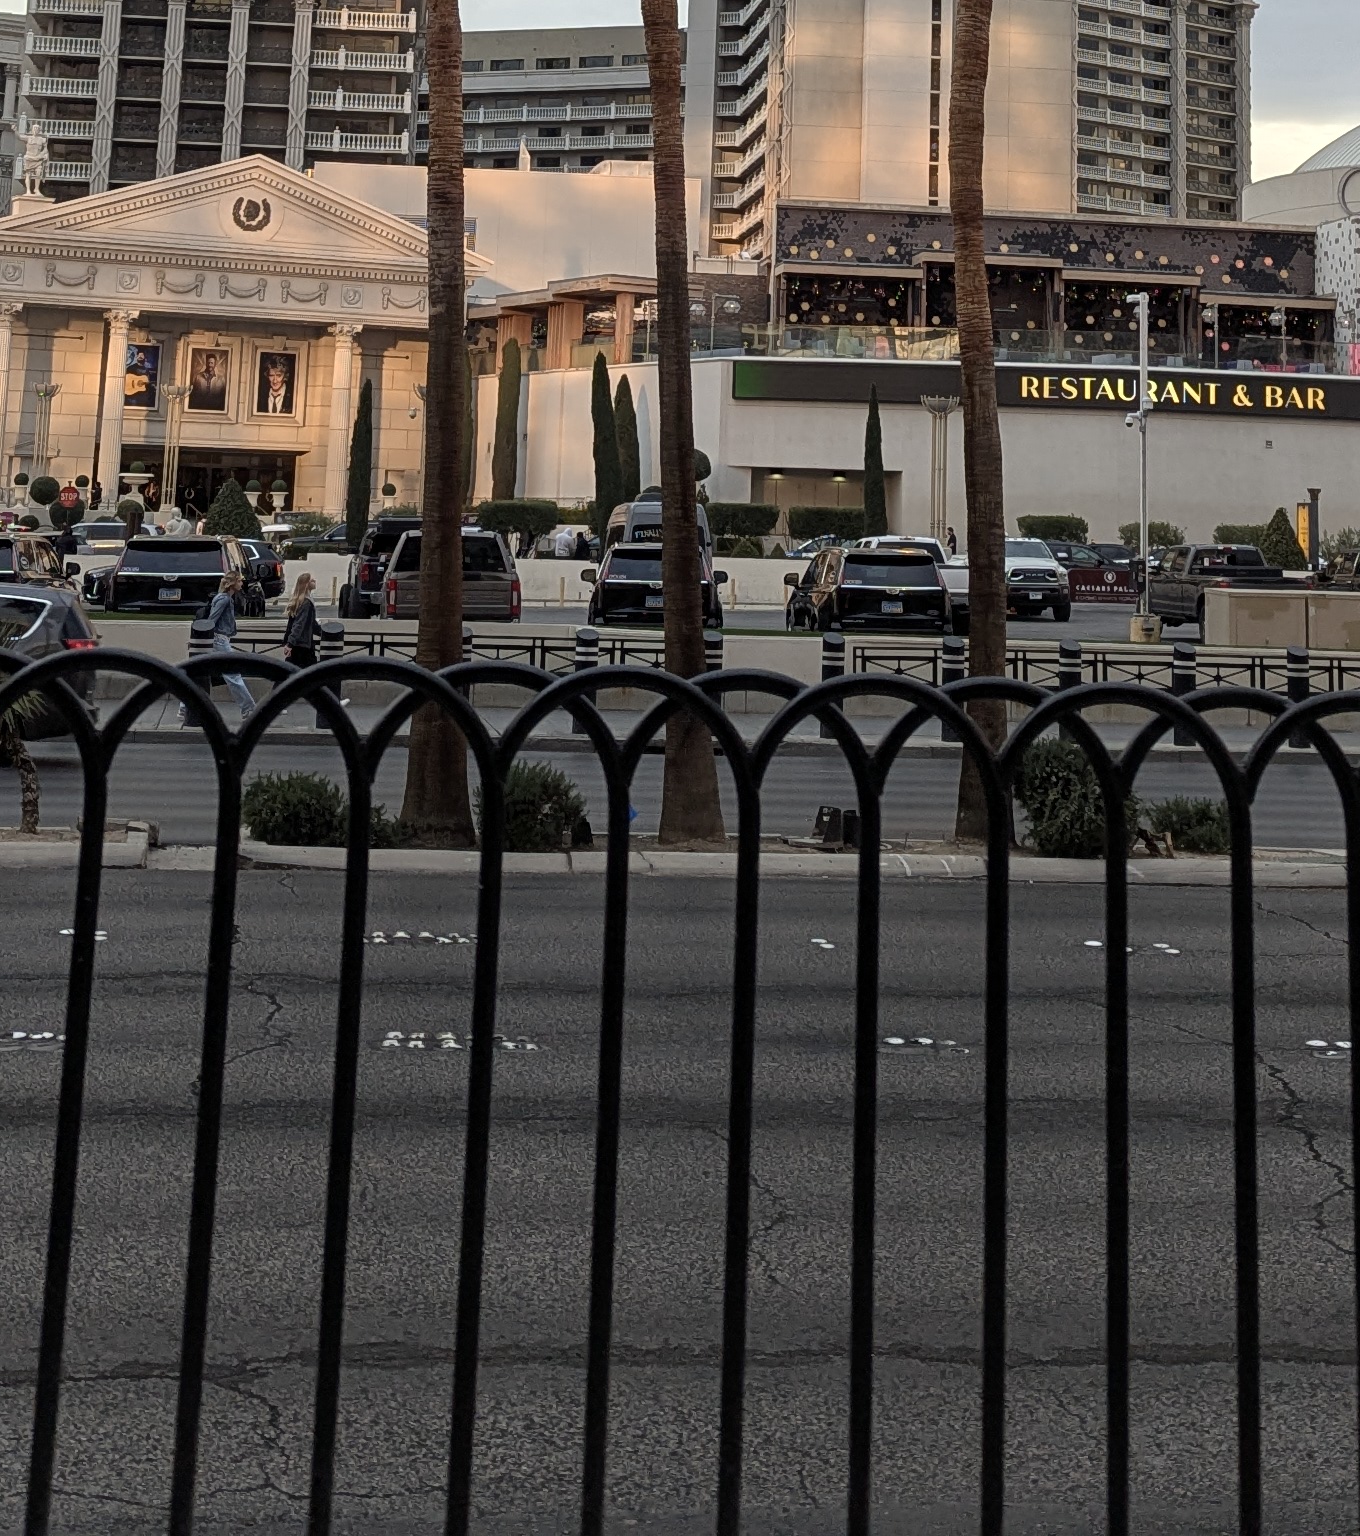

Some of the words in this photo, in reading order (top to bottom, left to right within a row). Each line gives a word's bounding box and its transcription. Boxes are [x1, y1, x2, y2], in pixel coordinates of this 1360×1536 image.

[1020, 374, 1222, 406] RESTAURANT
[1232, 383, 1254, 408] &
[1265, 385, 1326, 411] BAR
[60, 492, 78, 501] STOP
[1075, 584, 1111, 593] CAESARS
